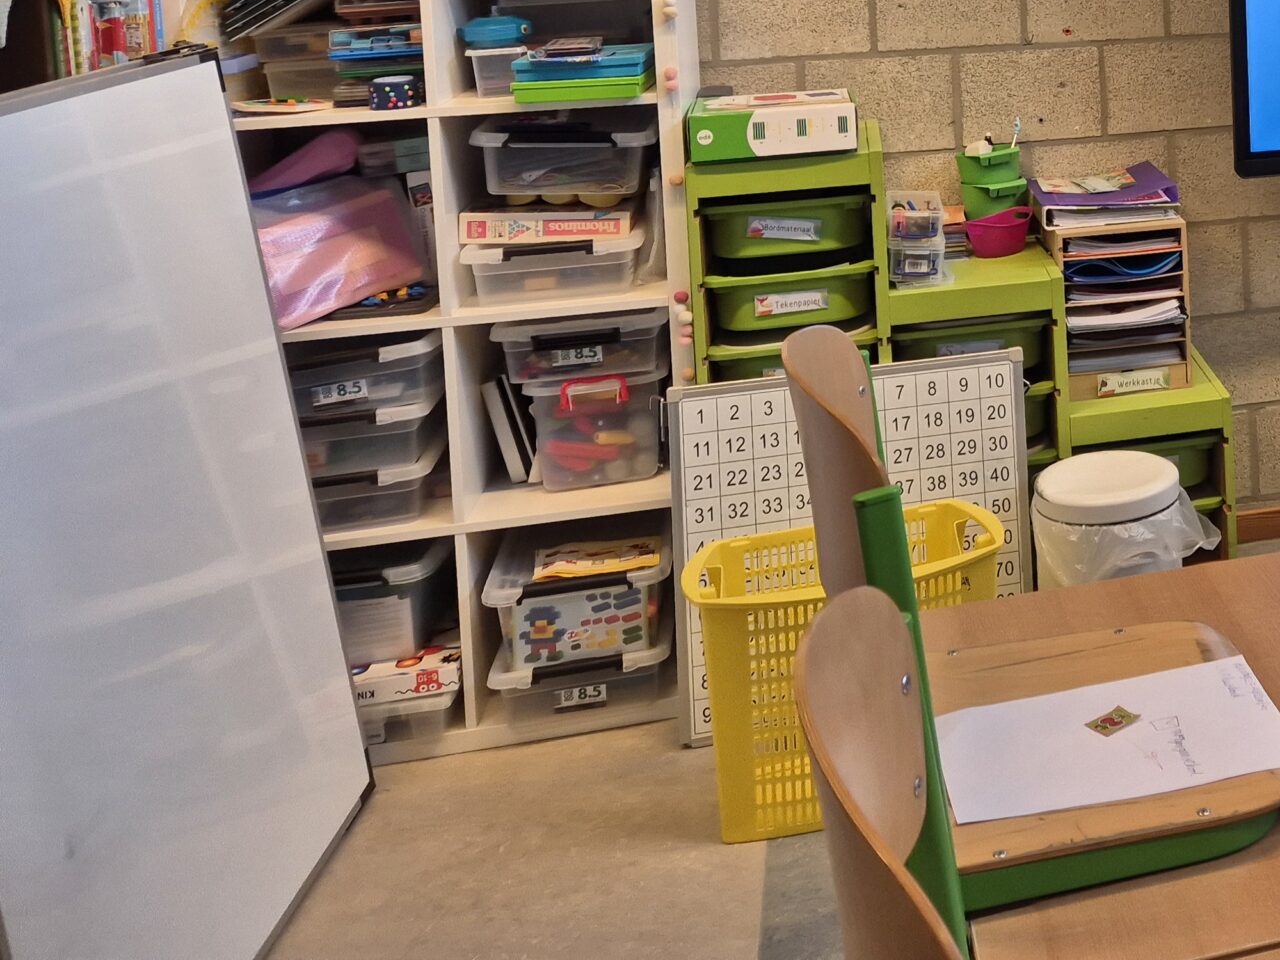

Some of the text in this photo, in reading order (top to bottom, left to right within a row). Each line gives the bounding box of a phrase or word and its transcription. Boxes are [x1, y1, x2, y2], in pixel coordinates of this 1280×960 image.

[549, 220, 617, 233] Triominos
[764, 223, 812, 233] Bordmateriaal
[775, 298, 820, 309] Tekenpapier
[575, 348, 597, 359] 8.5
[336, 381, 362, 396] 8.5
[1117, 377, 1161, 388] Werkkastje
[697, 373, 1004, 424] 1 2 3 7 8 9 10
[693, 441, 710, 458] 11
[726, 436, 746, 453] 12
[760, 432, 780, 448] 13
[892, 416, 910, 432] 17
[924, 412, 943, 428] 18
[956, 408, 974, 424] 19
[987, 404, 1006, 420] 20
[693, 473, 712, 491] 21
[727, 469, 748, 486] 22
[761, 464, 782, 482] 23
[894, 448, 913, 464] 27
[926, 443, 945, 460] 28
[957, 439, 977, 456] 29
[988, 435, 1008, 451] 30
[694, 506, 713, 524] 31
[728, 502, 749, 519] 32
[762, 497, 783, 514] 33
[927, 475, 946, 492] 38
[958, 470, 978, 487] 39
[990, 466, 1010, 482] 40
[992, 498, 1011, 514] 50
[996, 561, 1013, 578] 70
[578, 685, 602, 699] 8.5
